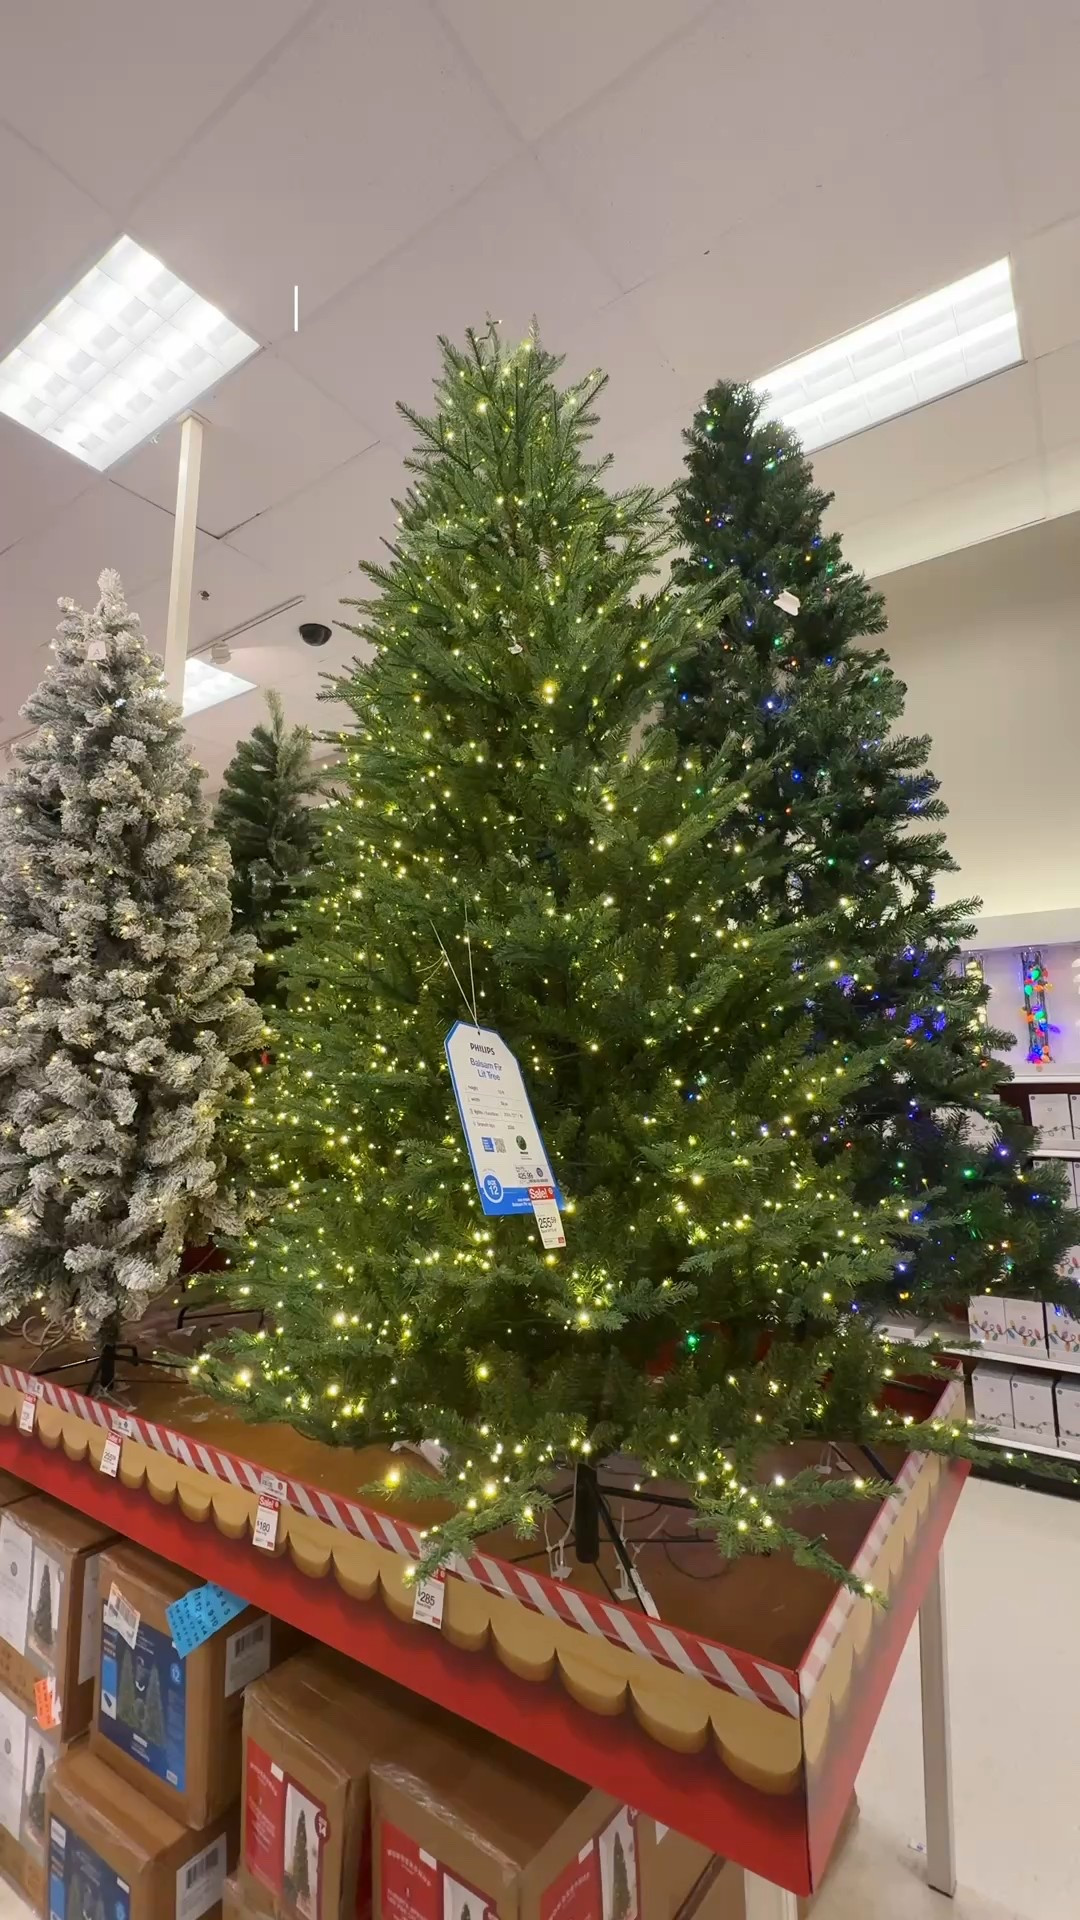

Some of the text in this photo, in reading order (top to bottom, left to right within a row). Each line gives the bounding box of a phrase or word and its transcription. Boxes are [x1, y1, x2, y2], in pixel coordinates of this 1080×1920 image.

[470, 1042, 495, 1056] PHILIPS
[470, 1057, 502, 1071] Balsam Fir
[477, 1069, 501, 1081] Lit Tree
[489, 1186, 499, 1196] 12
[529, 1187, 549, 1199] Sale!
